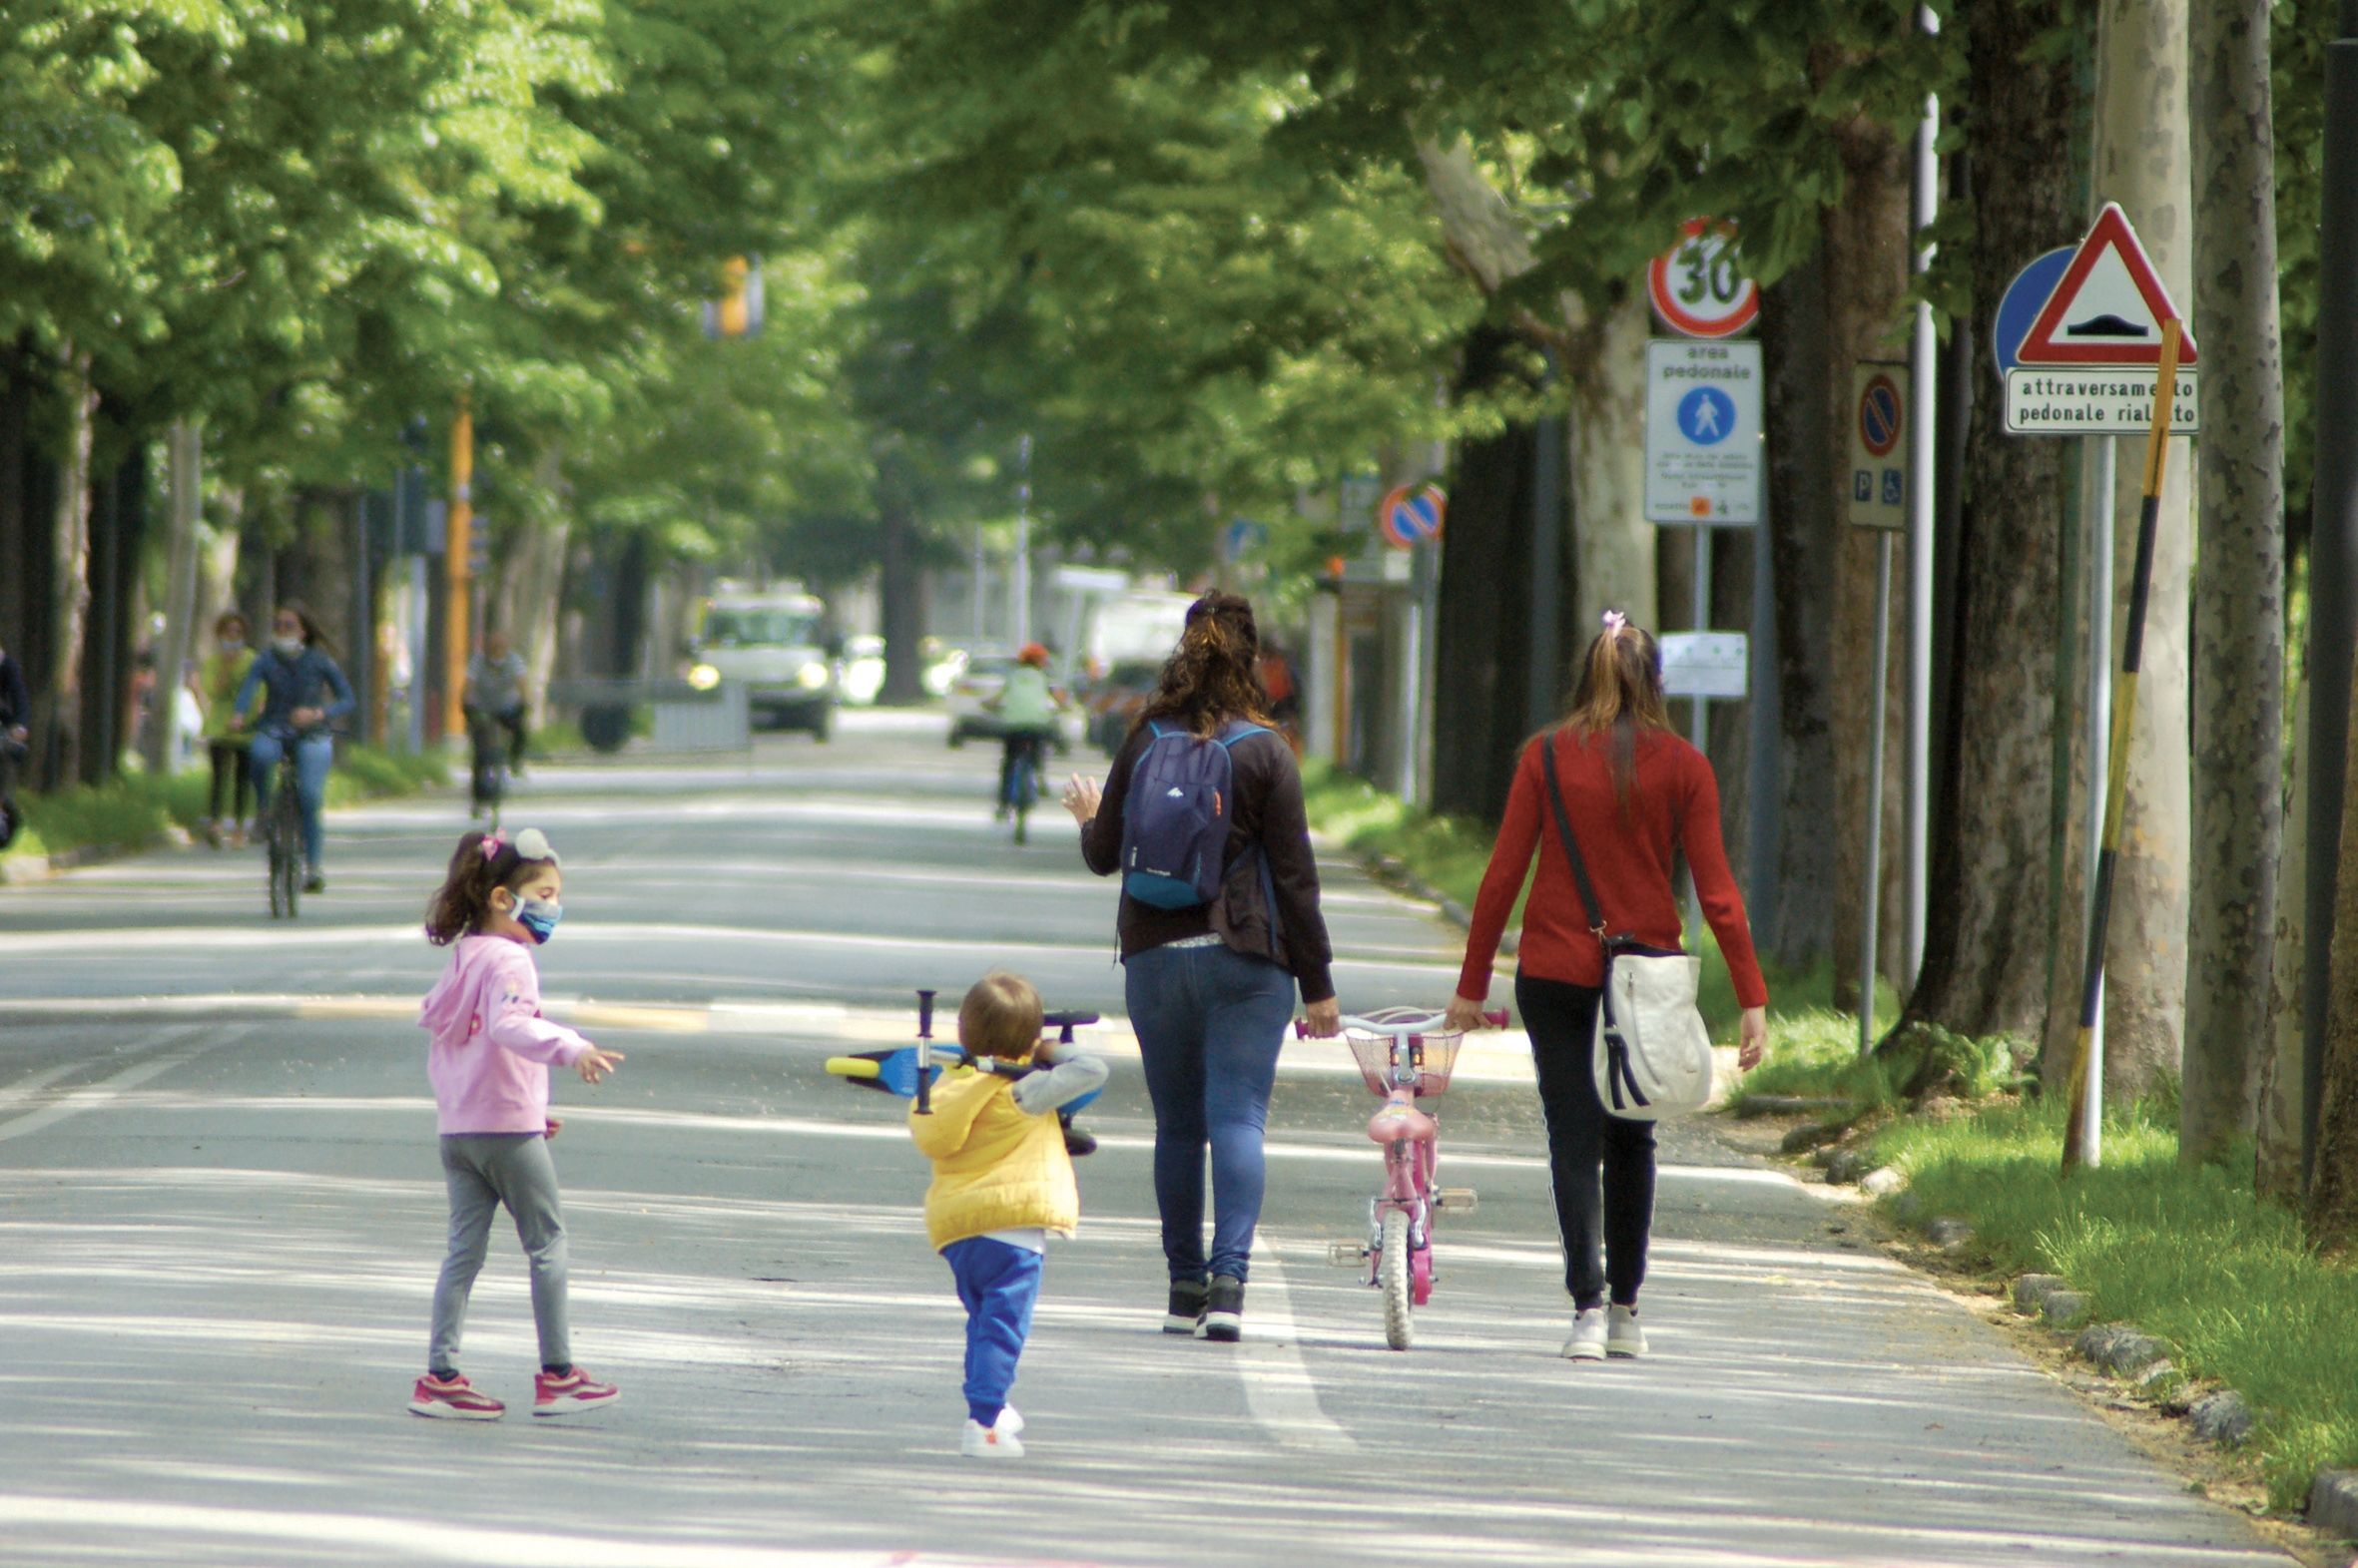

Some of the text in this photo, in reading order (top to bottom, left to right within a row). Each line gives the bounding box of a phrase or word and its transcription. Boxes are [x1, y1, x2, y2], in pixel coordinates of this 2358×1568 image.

[1677, 244, 1740, 304] 30
[1686, 346, 1728, 358] area
[1663, 364, 1751, 380] pedonale
[2023, 378, 2192, 396] attraversameto
[2020, 403, 2195, 425] pedonale rialto
[1859, 474, 1869, 497] P
